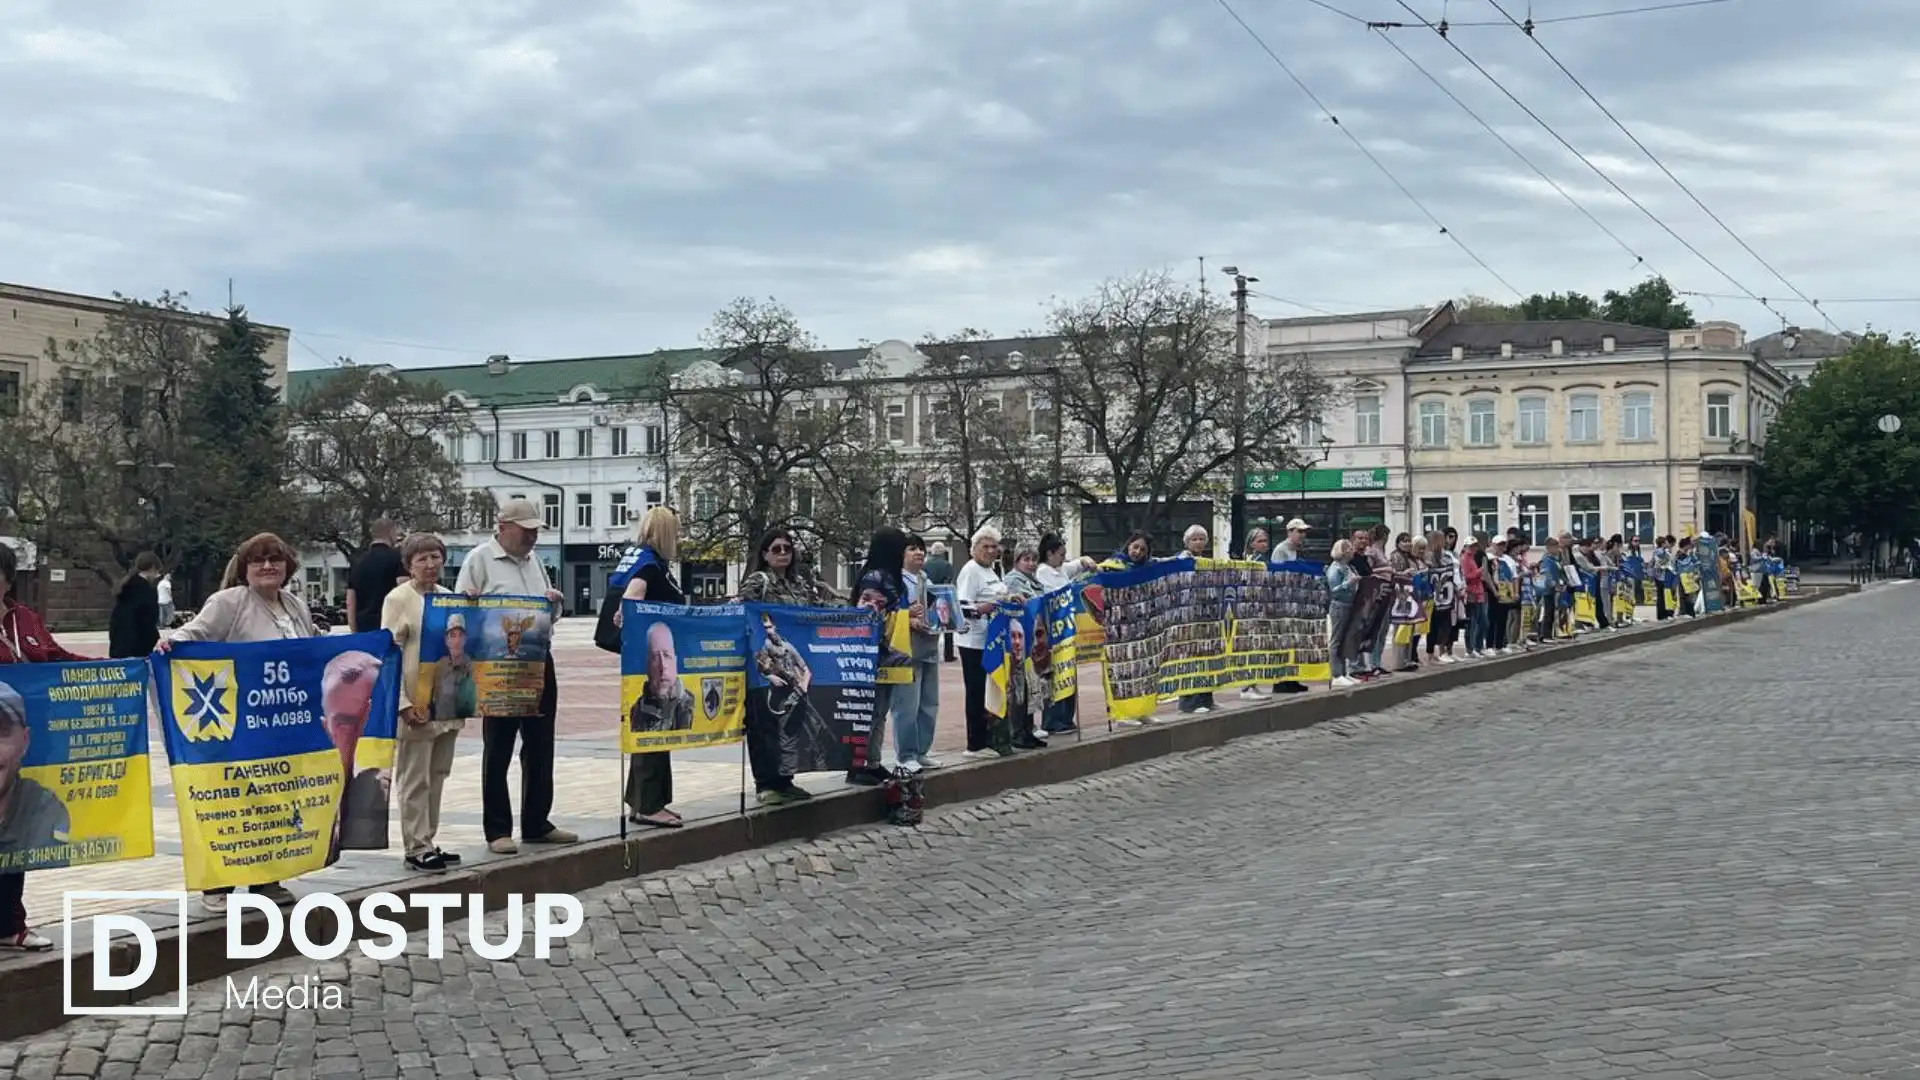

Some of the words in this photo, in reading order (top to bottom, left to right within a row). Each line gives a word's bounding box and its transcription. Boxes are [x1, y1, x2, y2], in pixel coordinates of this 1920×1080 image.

[598, 544, 622, 558] Ябк
[62, 668, 98, 683] ПАНОВ
[99, 666, 126, 681] ОЛЕГ
[264, 661, 290, 685] 56
[247, 687, 308, 707] ОМПбр
[272, 709, 312, 728] А0989
[223, 760, 291, 781] ГАНЕНКО
